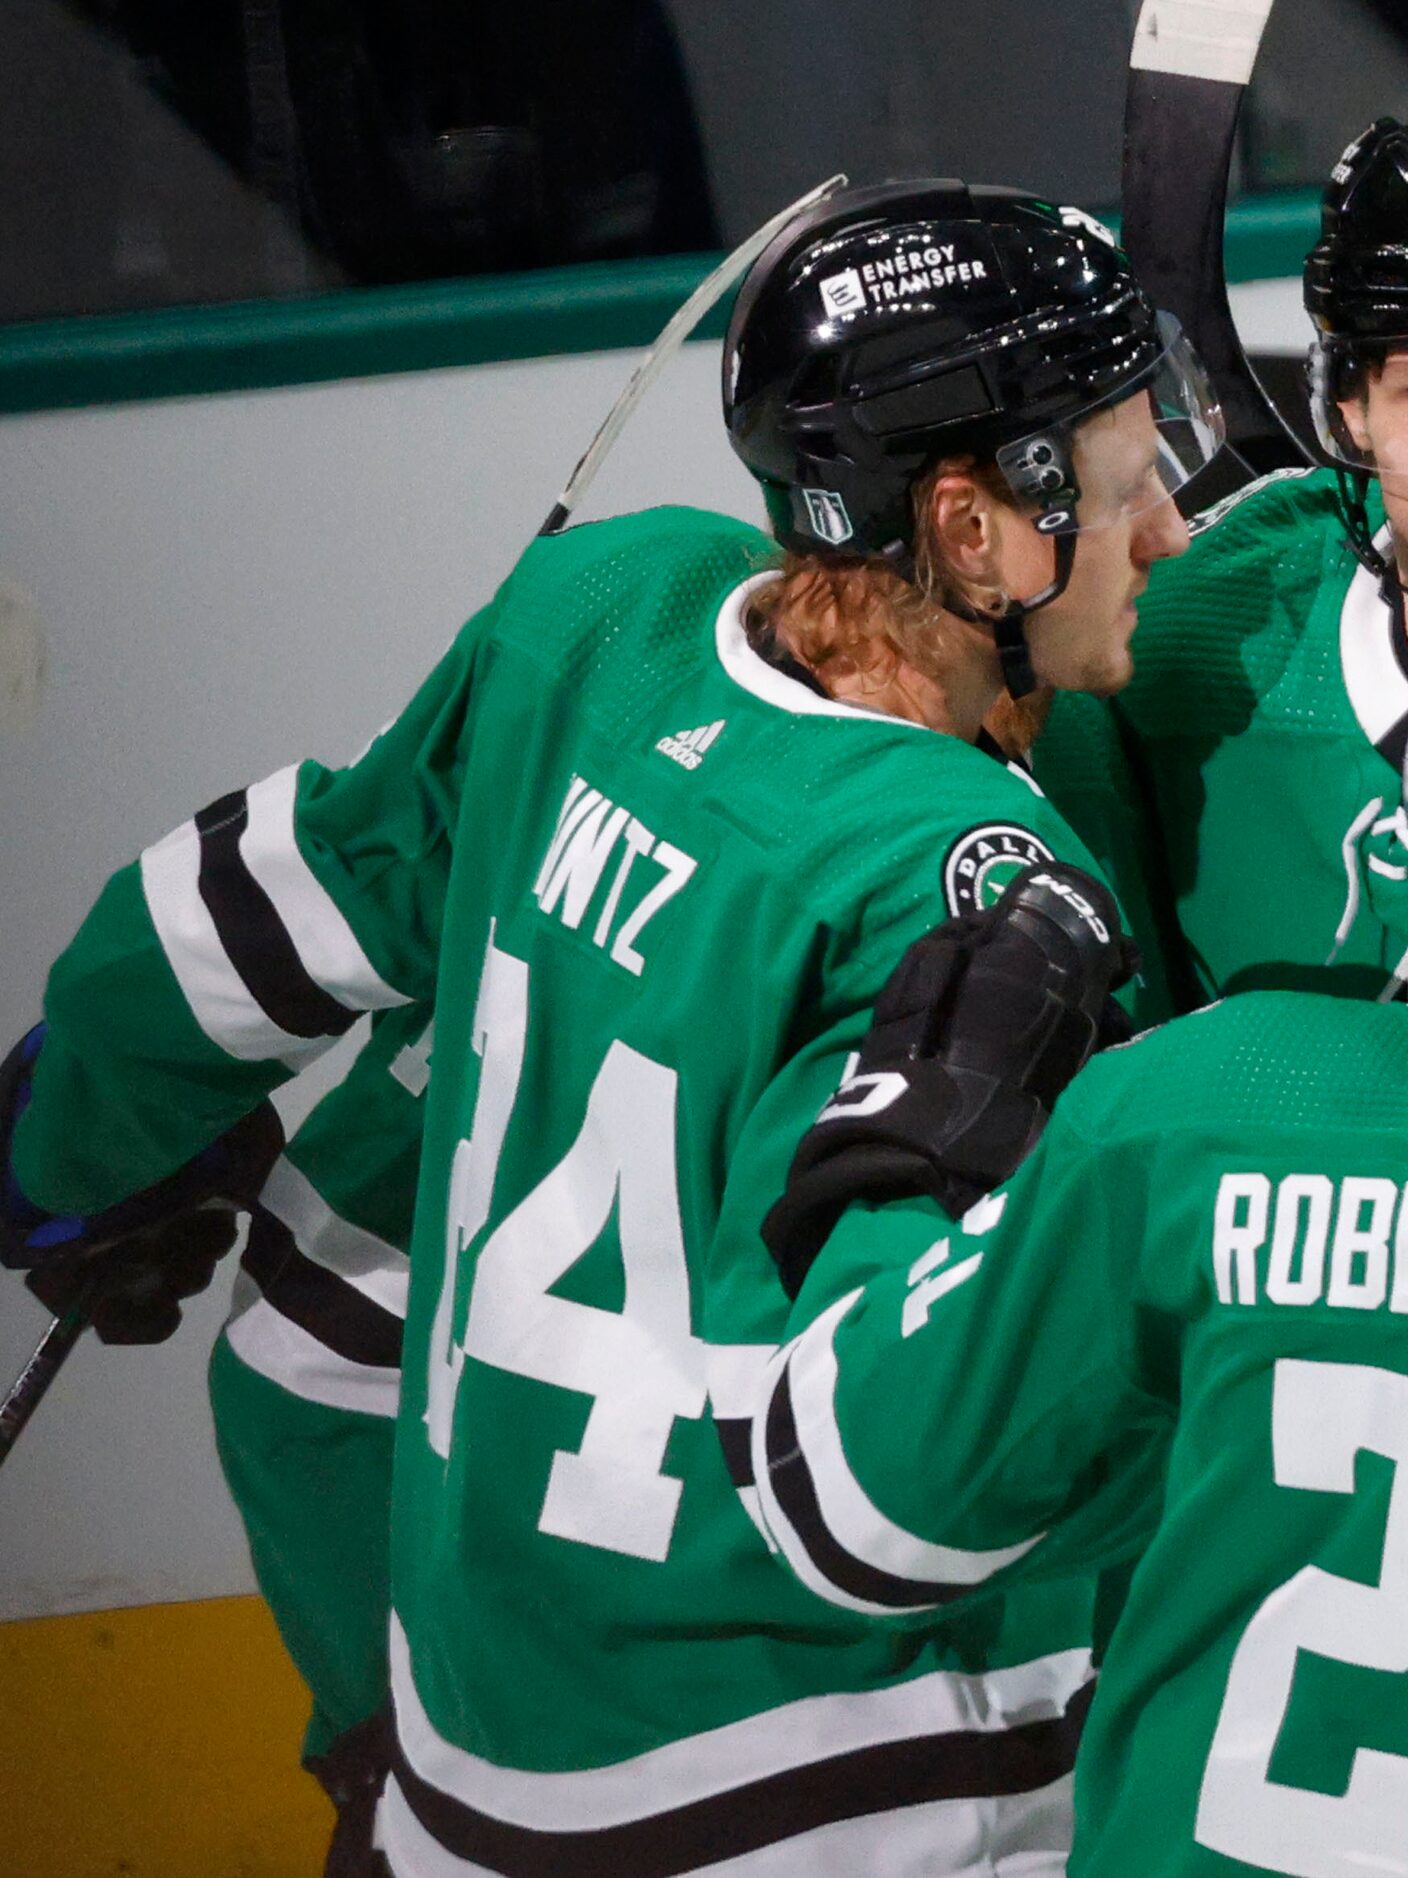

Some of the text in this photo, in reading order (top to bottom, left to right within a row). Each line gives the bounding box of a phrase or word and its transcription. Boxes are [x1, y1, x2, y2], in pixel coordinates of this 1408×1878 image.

[862, 243, 955, 283] ENERGY
[867, 260, 987, 302] TRANSFER
[654, 735, 703, 771] adidas
[957, 835, 1040, 879] DALL
[1029, 873, 1111, 943] CCM
